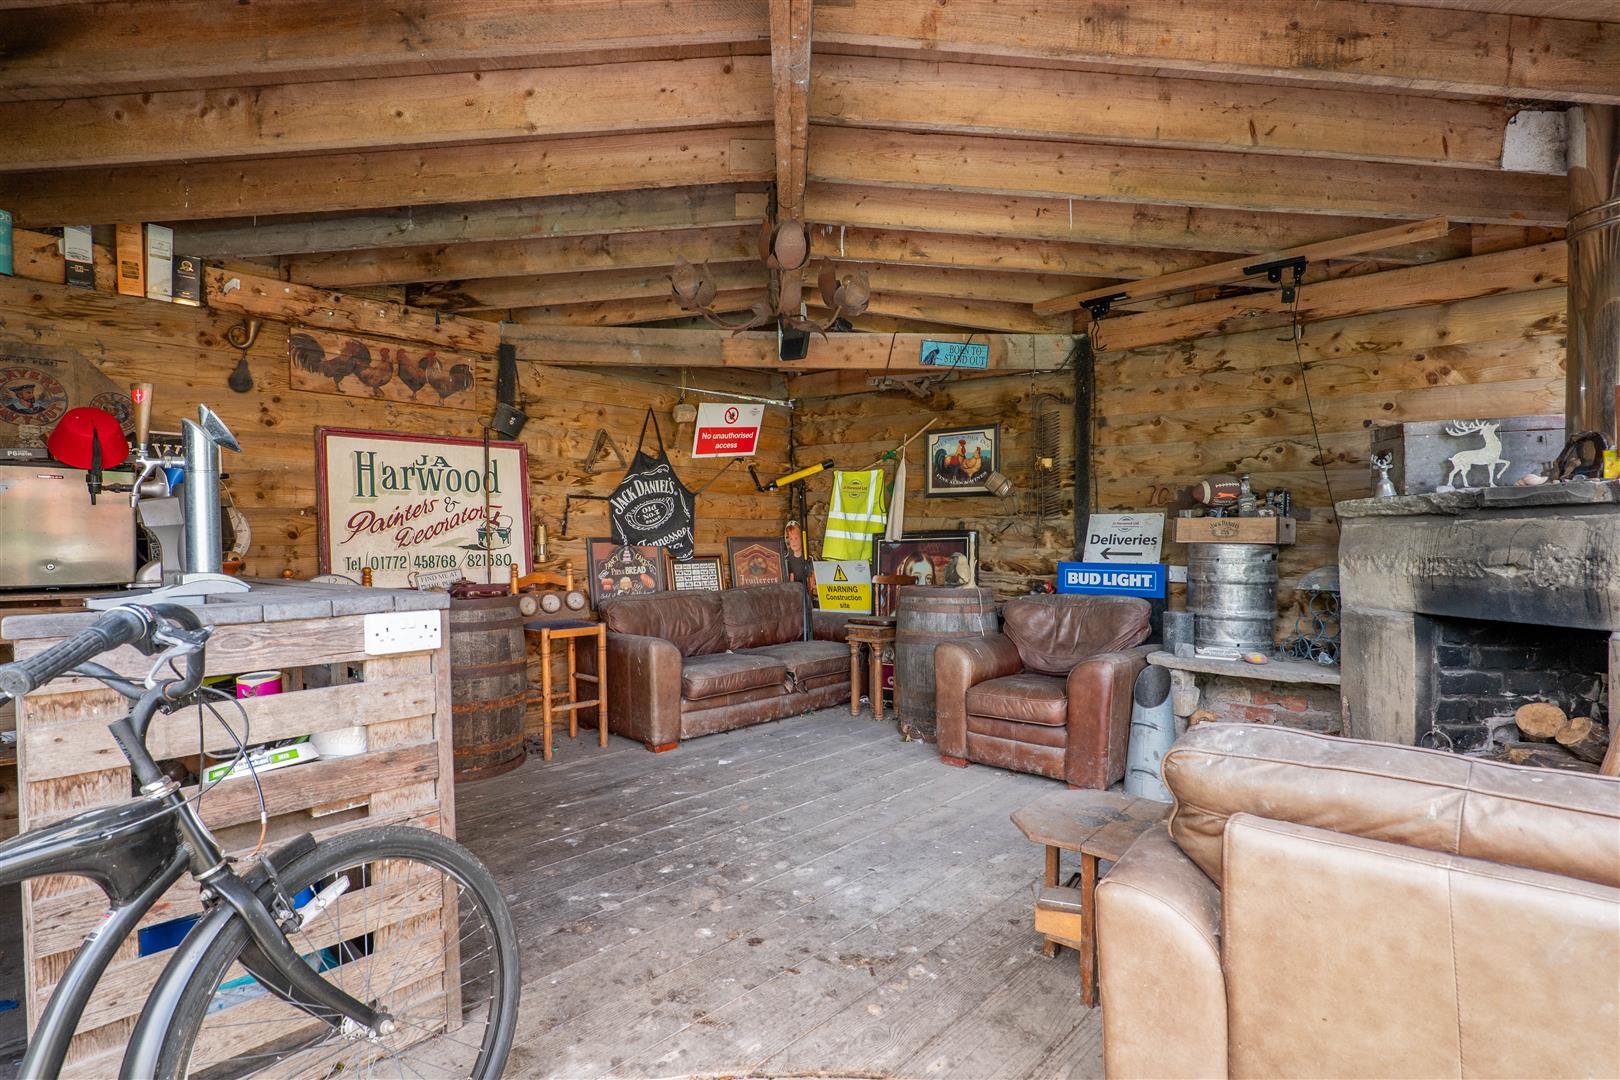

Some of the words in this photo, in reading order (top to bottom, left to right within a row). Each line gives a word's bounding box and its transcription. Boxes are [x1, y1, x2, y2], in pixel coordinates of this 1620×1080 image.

[949, 344, 969, 355] BORN
[971, 346, 982, 356] TO
[944, 353, 968, 365] STAND
[970, 355, 985, 366] OUT
[702, 432, 711, 440] No
[712, 431, 754, 440] unauthorised
[354, 450, 502, 498] Harwood
[610, 486, 638, 515] JACK
[633, 477, 675, 498] DANIEL'S
[642, 504, 657, 514] Old
[341, 498, 440, 544] Painters
[444, 497, 461, 513] &
[395, 505, 502, 549] Decorators
[637, 526, 688, 547] Tennessee
[1090, 534, 1158, 546] Deliveries
[345, 556, 361, 571] Tel
[414, 555, 457, 568] 458768
[625, 566, 646, 575] BREAD
[1067, 571, 1102, 585] BUD
[1102, 573, 1153, 588] LIGHT
[827, 585, 859, 593] WARNING
